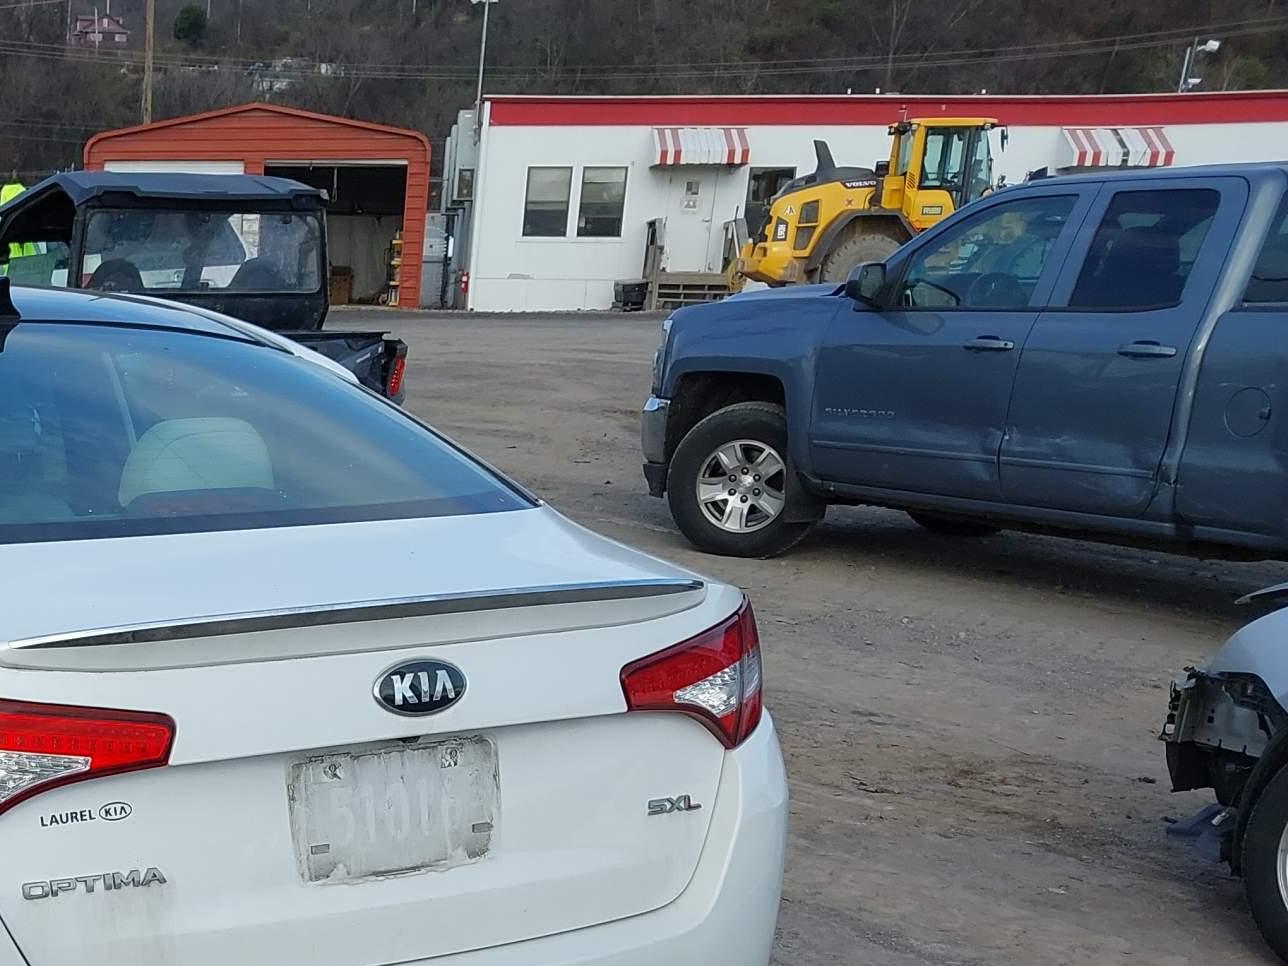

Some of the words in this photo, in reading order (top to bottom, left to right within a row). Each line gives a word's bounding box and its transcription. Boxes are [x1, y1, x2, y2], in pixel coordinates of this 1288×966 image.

[845, 180, 877, 188] VOLVO
[391, 669, 456, 706] KIA
[647, 794, 702, 816] SXL
[39, 809, 97, 828] LAUREL
[21, 866, 168, 901] OPTIMA
